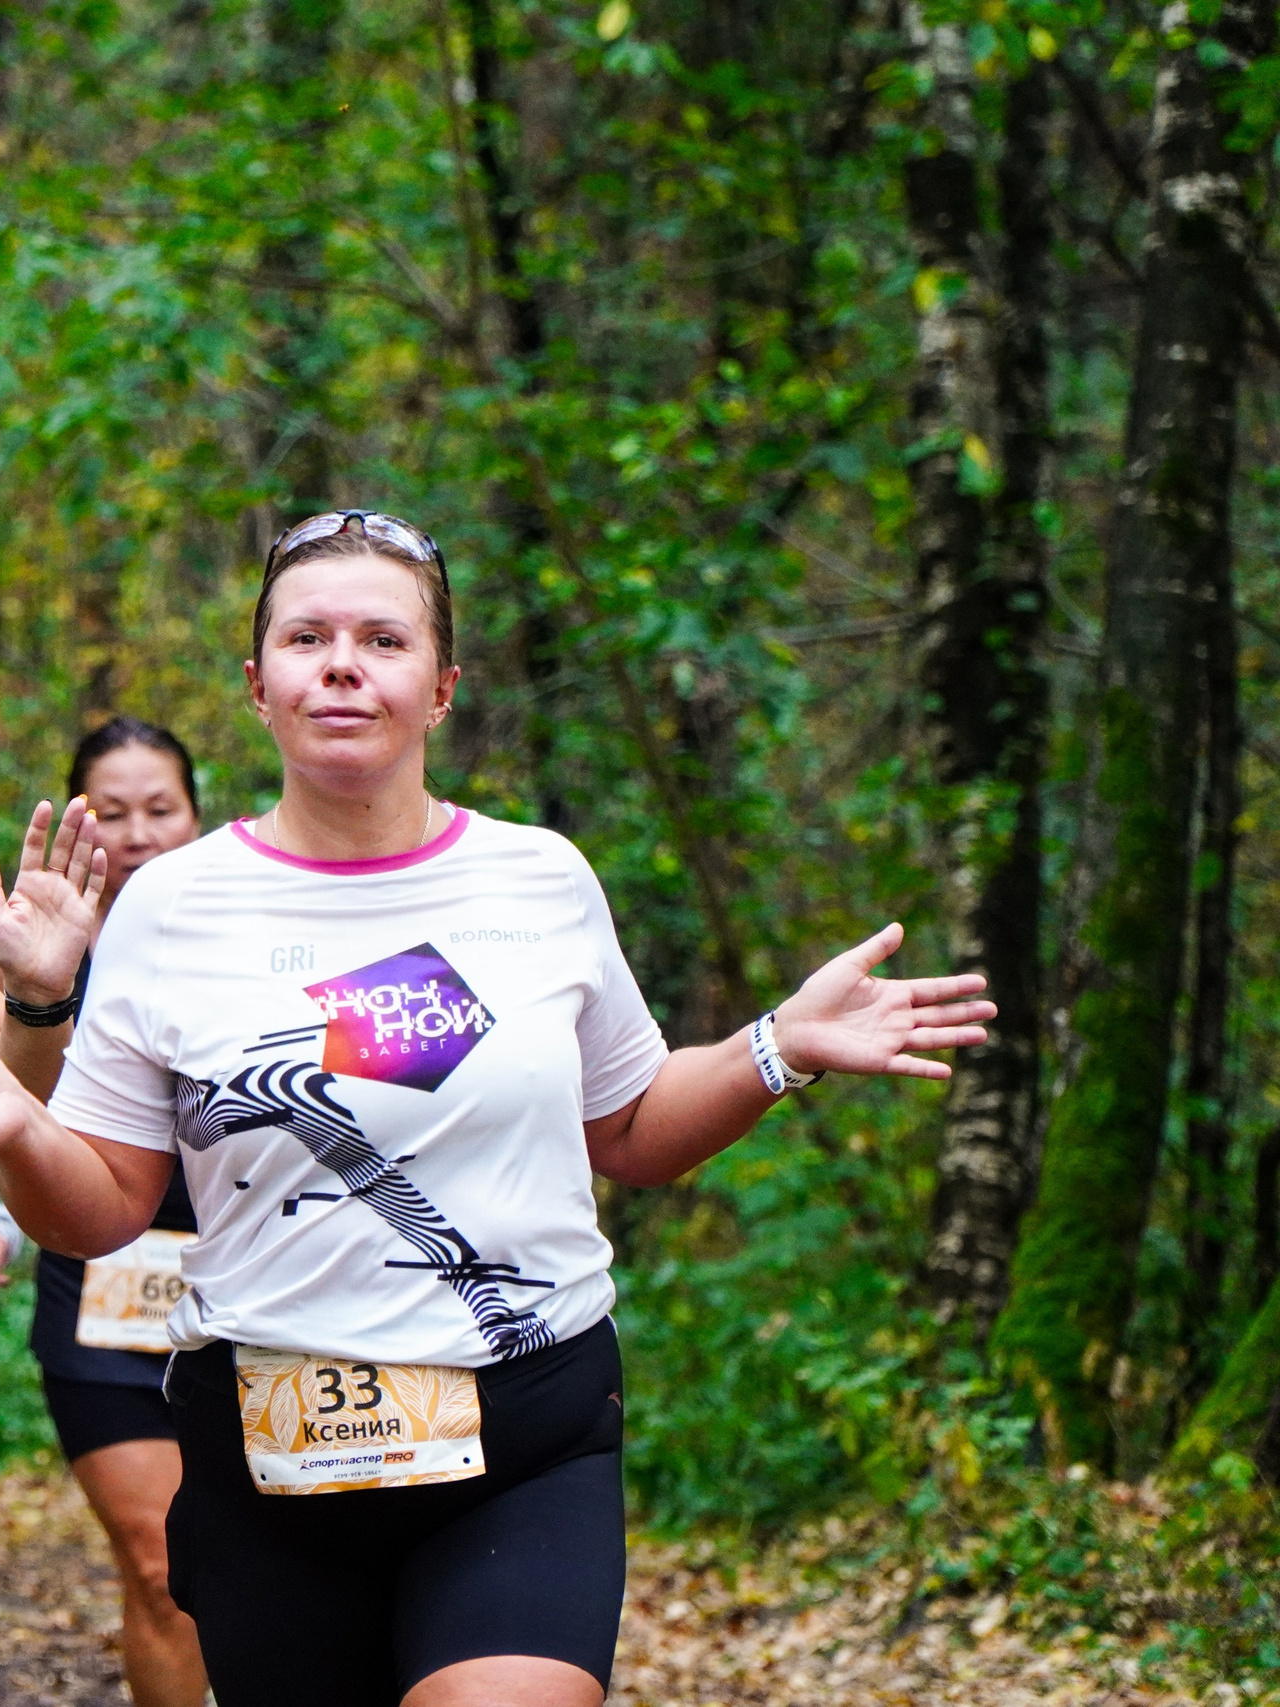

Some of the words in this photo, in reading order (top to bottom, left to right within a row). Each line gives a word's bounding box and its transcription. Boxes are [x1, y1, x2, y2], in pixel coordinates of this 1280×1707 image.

[270, 943, 315, 974] GRi
[359, 1038, 447, 1059] ЗАБЕГ
[315, 1364, 384, 1415] 33
[303, 1418, 401, 1443] Ксения
[384, 1452, 415, 1463] PRO
